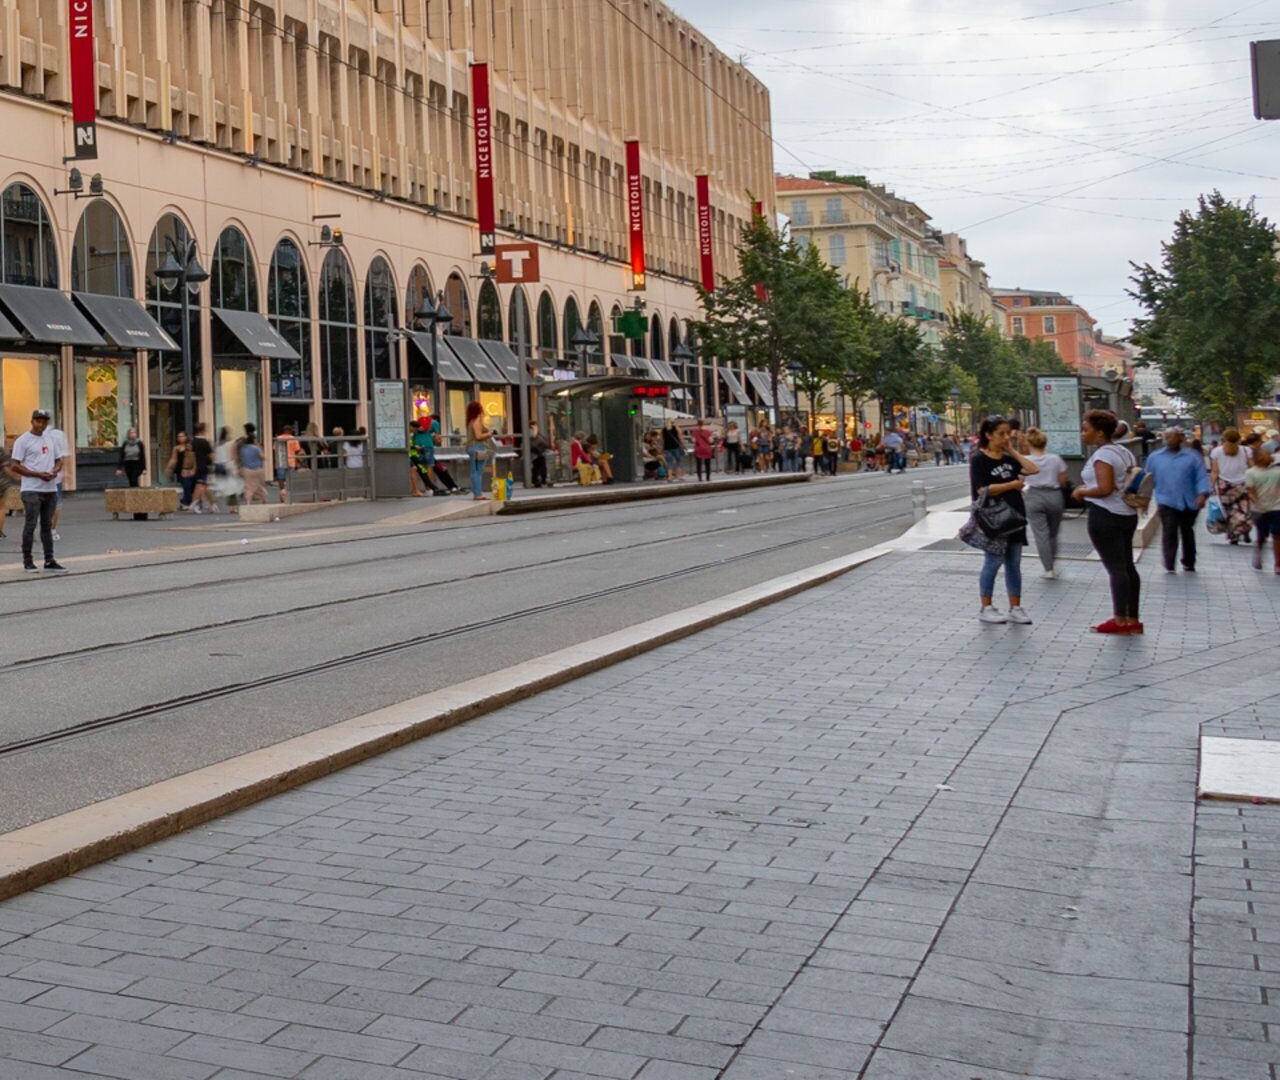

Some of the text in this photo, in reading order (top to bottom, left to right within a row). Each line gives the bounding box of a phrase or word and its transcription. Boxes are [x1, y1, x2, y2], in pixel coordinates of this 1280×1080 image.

[477, 107, 490, 178] NICETOILE
[630, 175, 640, 231] NICETOILE
[700, 205, 710, 255] NICETOILE
[501, 250, 530, 279] T
